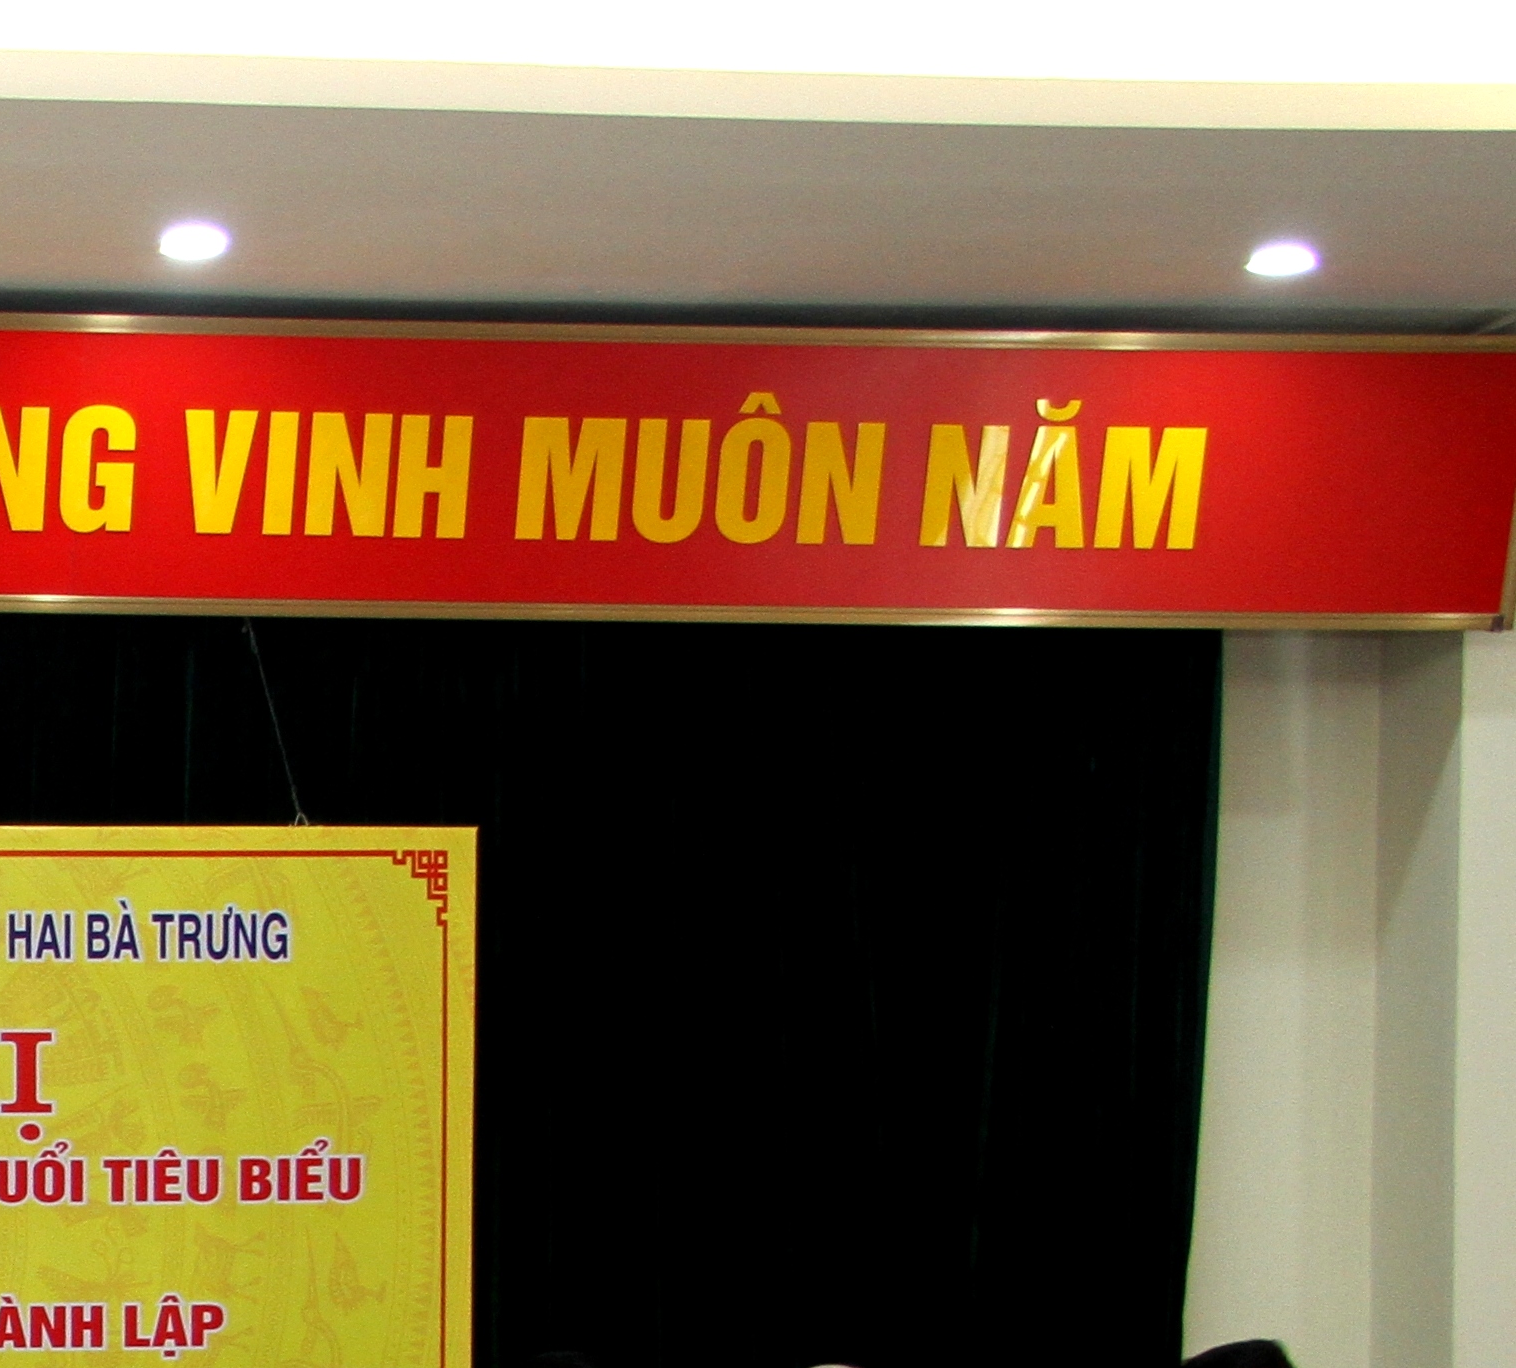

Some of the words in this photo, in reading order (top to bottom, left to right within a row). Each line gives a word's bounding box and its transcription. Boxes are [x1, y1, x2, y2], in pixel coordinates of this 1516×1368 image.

[185, 409, 473, 538] VINH
[516, 393, 885, 544] MUÔN
[920, 399, 1207, 549] NĂM
[9, 913, 71, 959] HAI
[88, 901, 139, 959] BÀ
[152, 906, 288, 960] TRƯNG
[104, 1150, 220, 1203] TIÊU
[240, 1140, 361, 1202] BIỂU
[124, 1295, 224, 1357] LẬP
